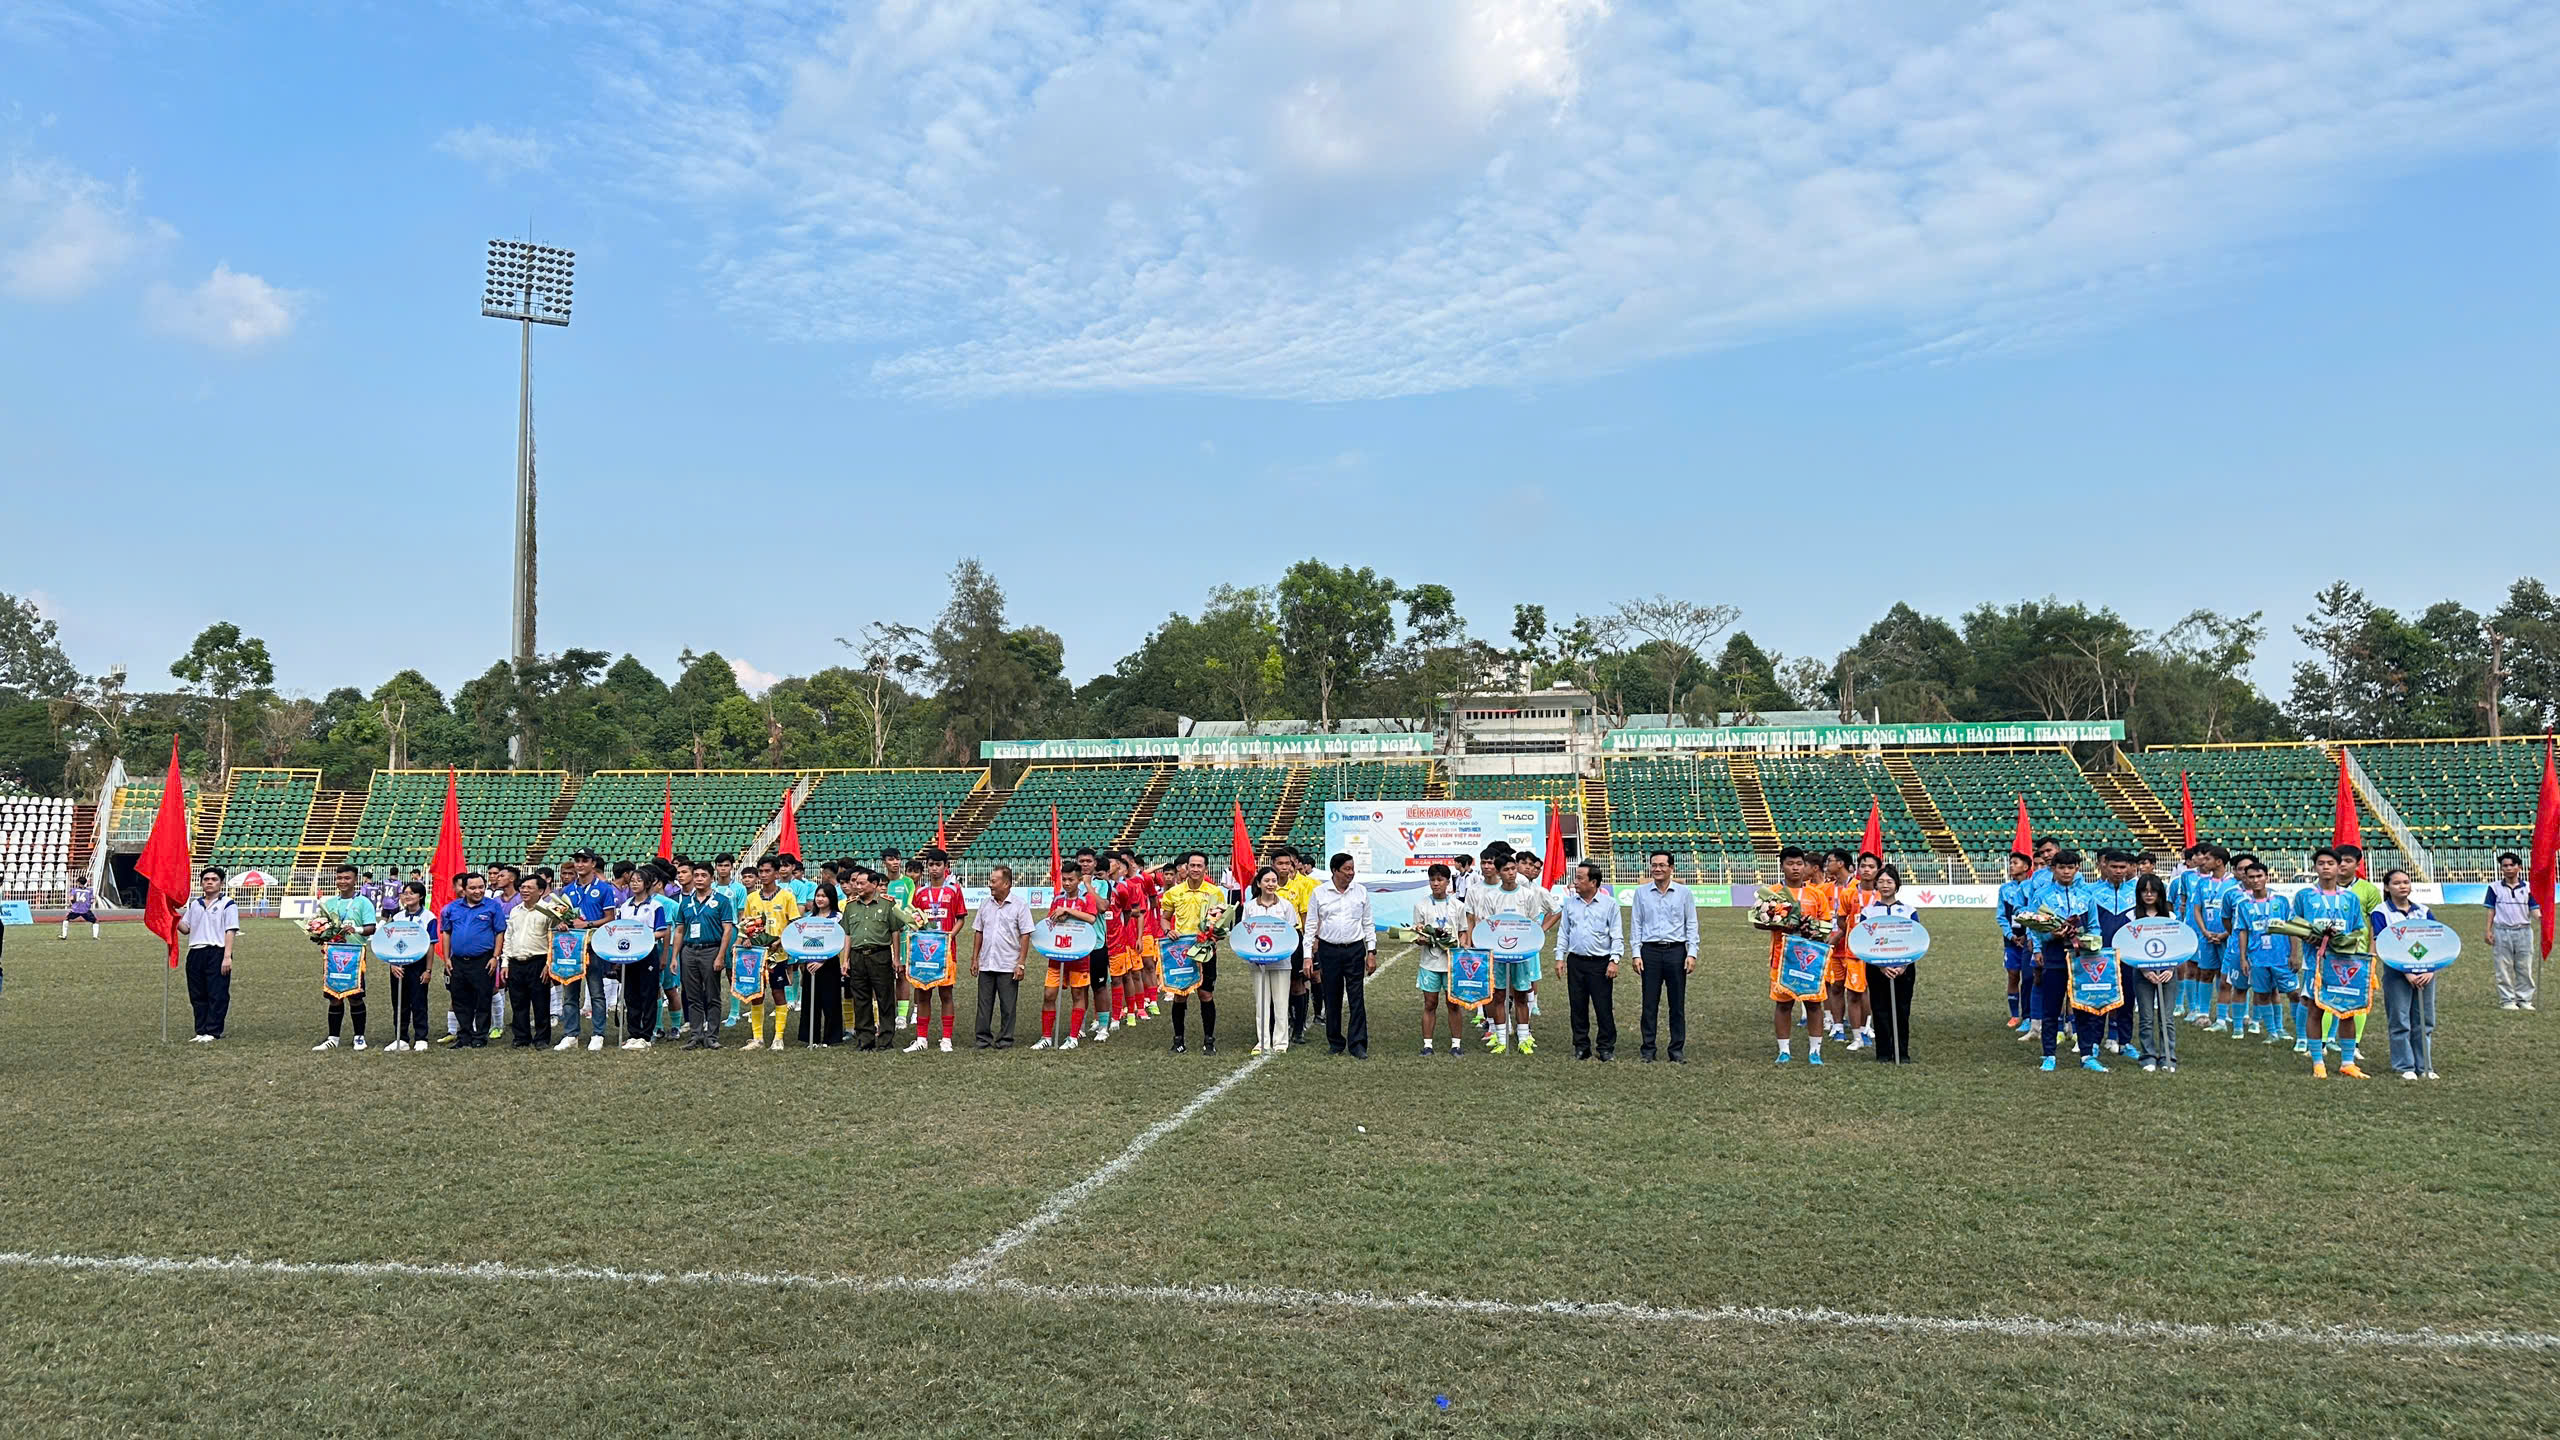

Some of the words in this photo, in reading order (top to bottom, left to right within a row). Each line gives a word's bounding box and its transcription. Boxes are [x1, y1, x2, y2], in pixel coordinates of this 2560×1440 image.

[1613, 732, 1637, 747] XÂY
[1906, 728, 1941, 743] NHÂN
[1966, 727, 1994, 742] HÀO
[2034, 727, 2077, 741] THANH
[1050, 742, 1075, 757] XÂY
[1273, 740, 1302, 753] NAM
[370, 890, 376, 900] 8
[384, 886, 394, 897] 16
[1938, 894, 1988, 905] VPBank
